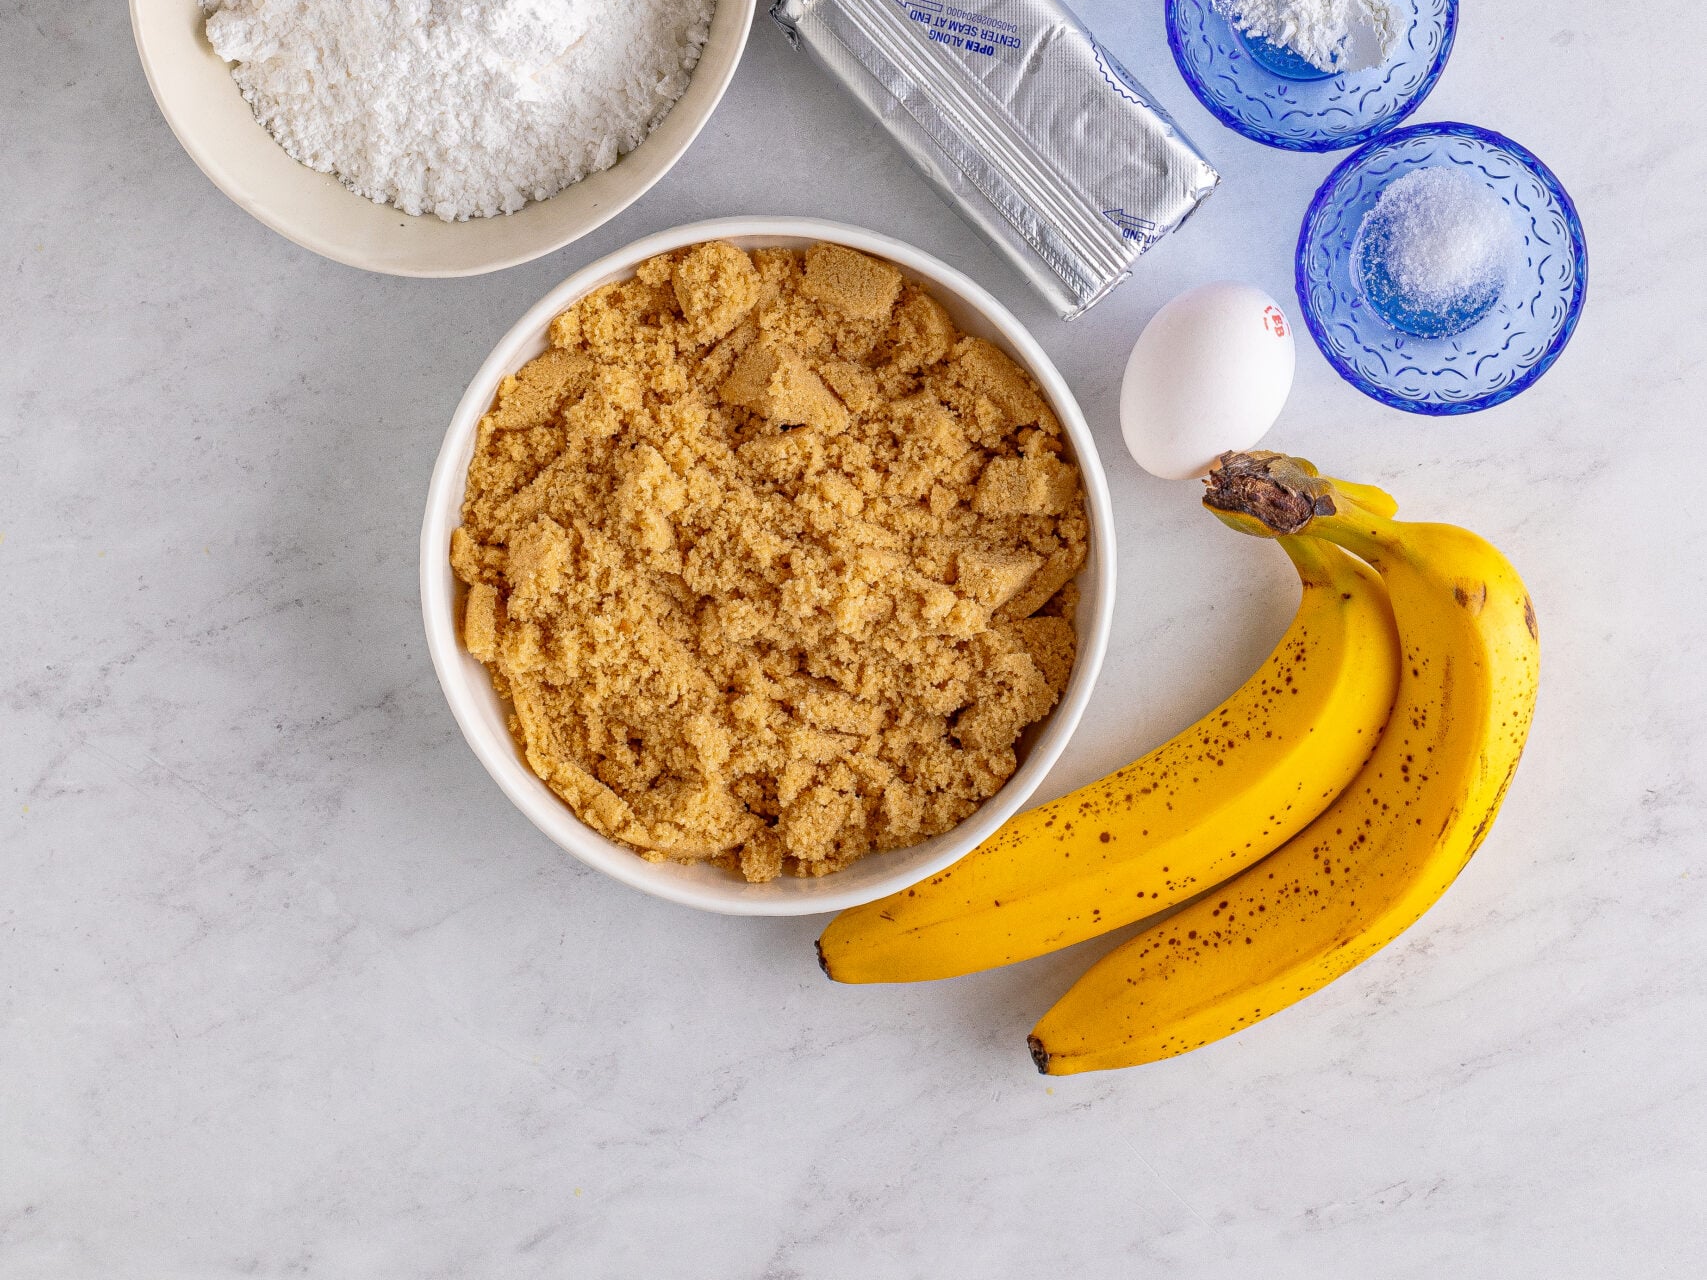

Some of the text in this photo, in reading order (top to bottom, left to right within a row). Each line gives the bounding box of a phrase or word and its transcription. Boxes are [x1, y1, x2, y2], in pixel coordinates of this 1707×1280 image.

[909, 9, 1021, 49] CENTER SEAM AT END
[928, 29, 995, 56] OPEN ALONG
